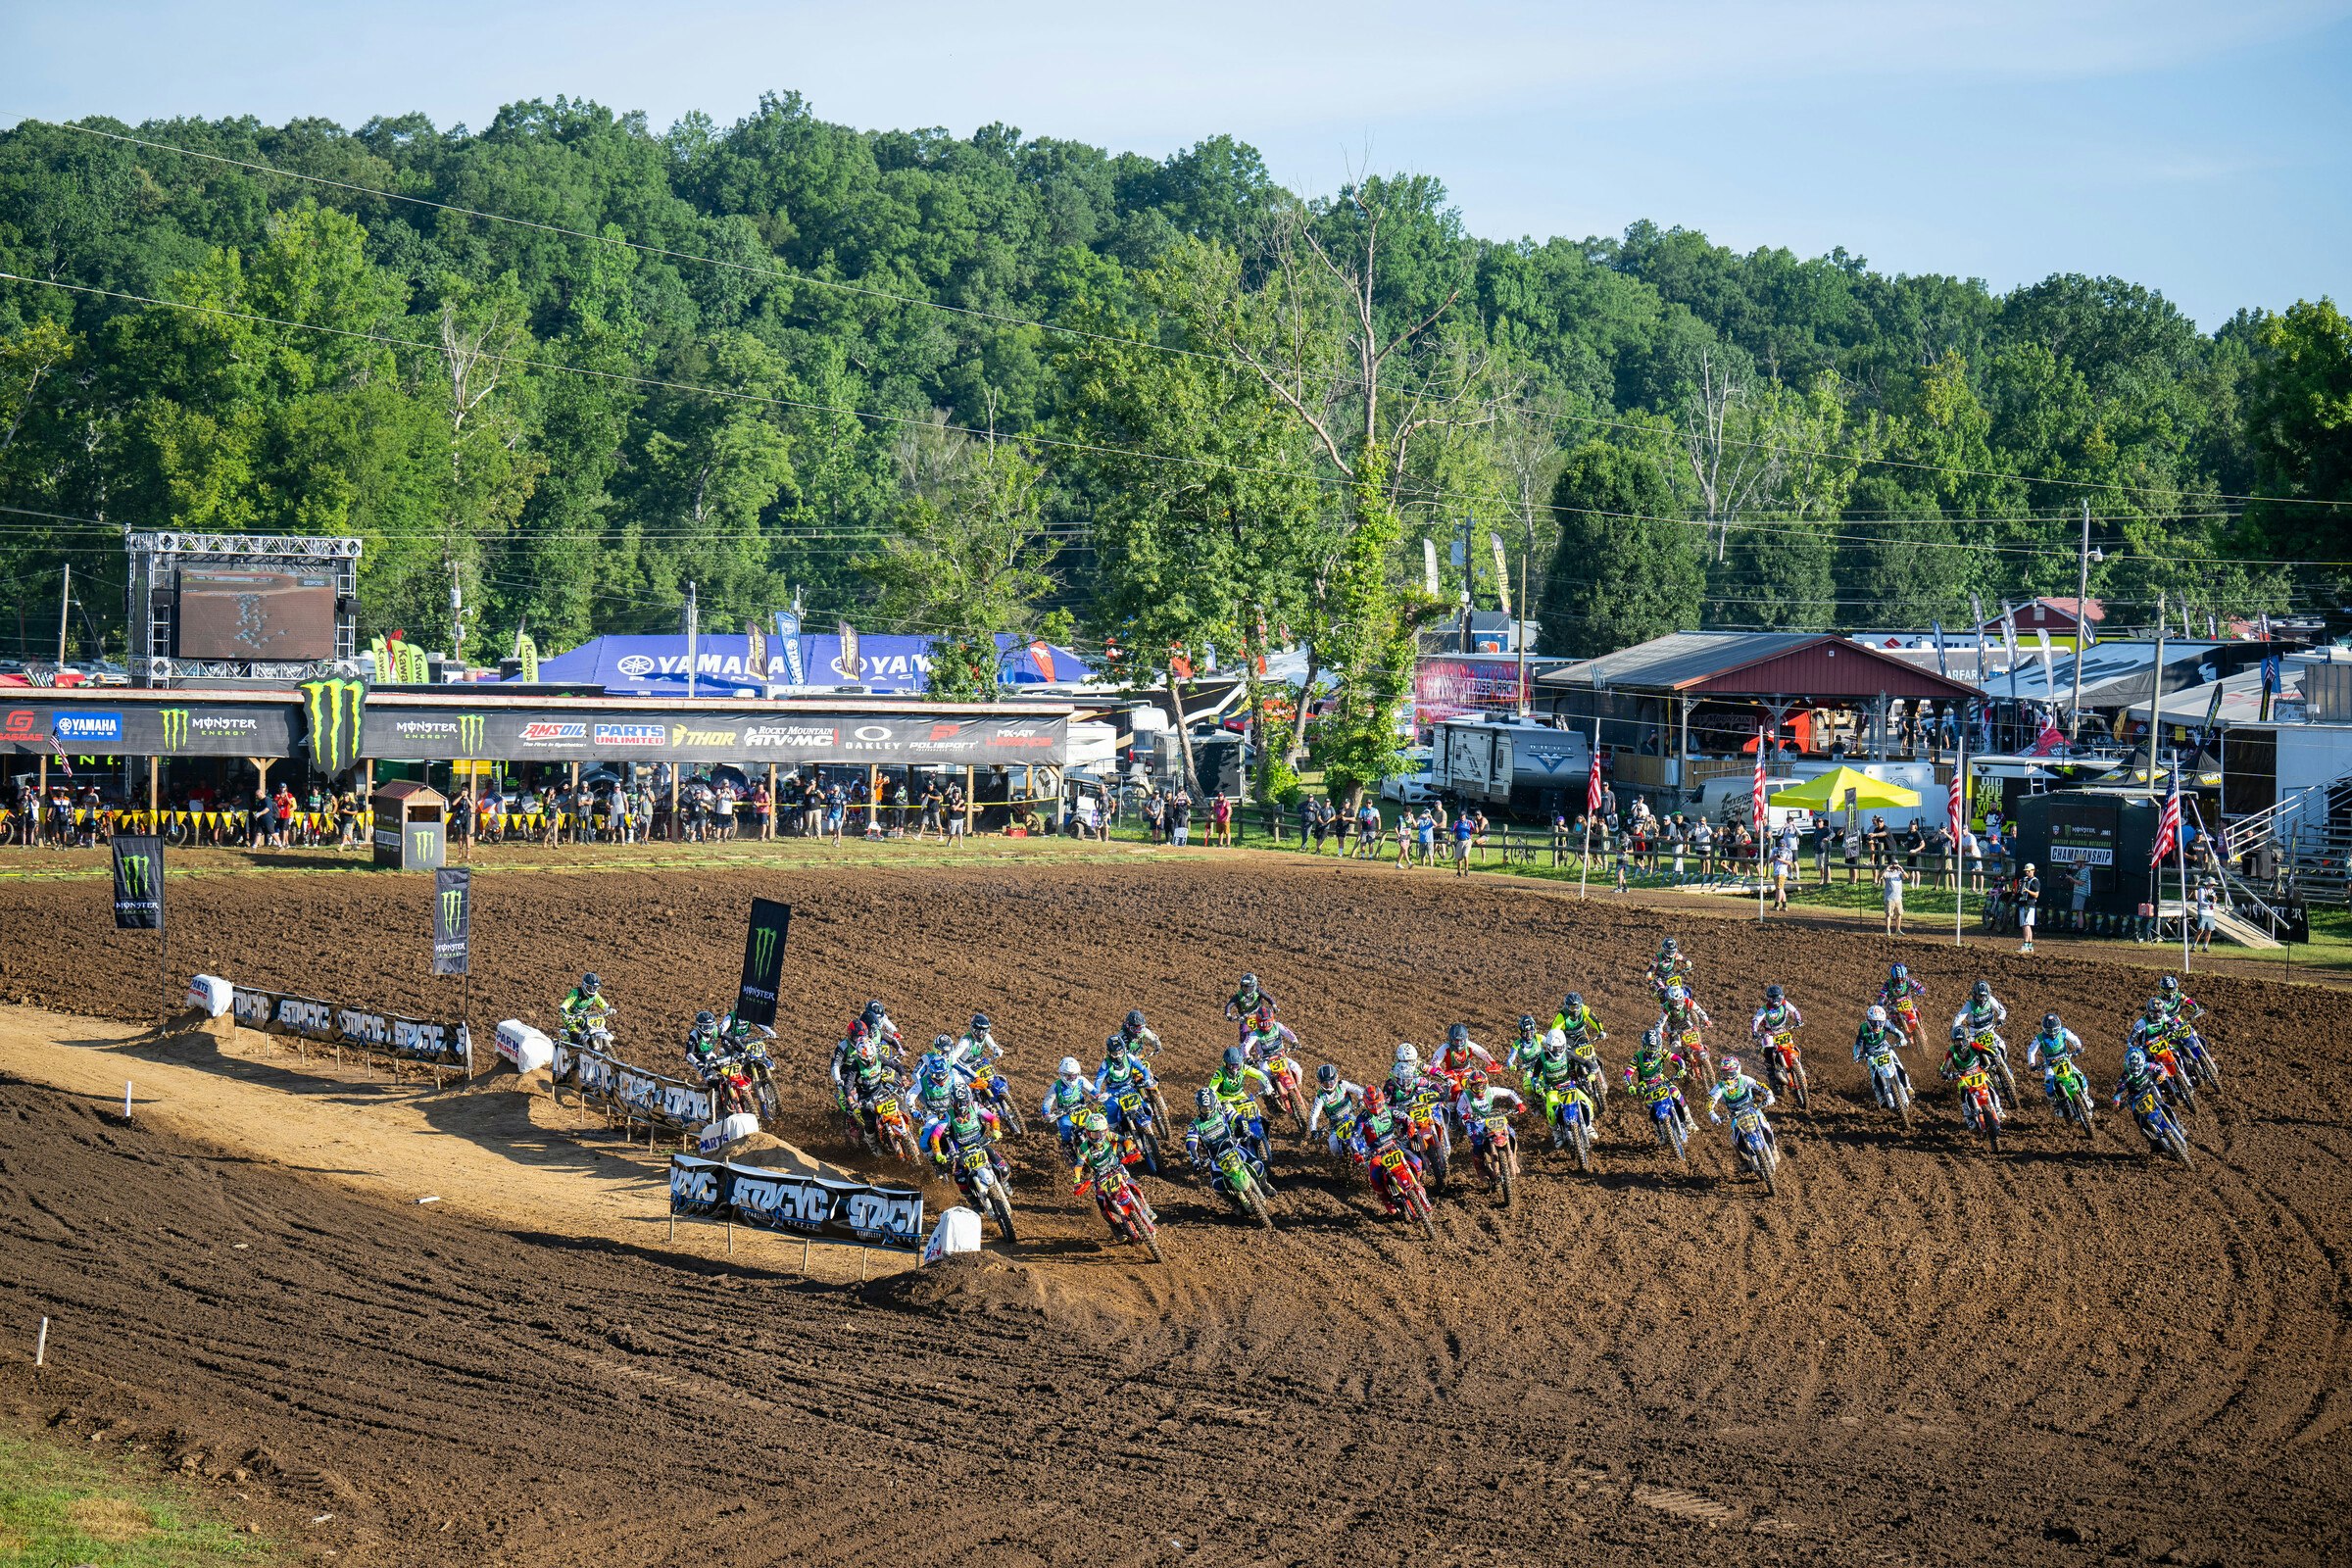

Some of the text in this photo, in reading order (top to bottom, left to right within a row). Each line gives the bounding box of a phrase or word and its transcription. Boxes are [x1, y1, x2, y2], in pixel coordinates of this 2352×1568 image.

[658, 654, 786, 676] YAMAA
[72, 718, 118, 731] YAMAHA
[192, 718, 257, 731] MONSTER
[396, 720, 459, 733] MONSTER
[527, 723, 586, 736] AMSOIL
[596, 725, 664, 737] PARTS
[759, 726, 833, 735] ROCKY MOUNTAIN
[687, 732, 736, 746] THOR
[1981, 777, 2004, 786] DID
[1977, 794, 2003, 803] SEE
[1977, 802, 2003, 811] YOR
[2052, 848, 2111, 863] CHAMPONSHIP
[115, 901, 160, 910] MONSTER
[435, 942, 466, 954] MONSTER
[743, 985, 776, 1002] MONSTER
[2152, 1042, 2168, 1054] 34
[1878, 1054, 1890, 1067] 65
[2057, 1063, 2071, 1075] 41
[1969, 1074, 1983, 1087] 11
[1560, 1090, 1575, 1104] 71
[1653, 1088, 1668, 1101] 52
[881, 1100, 897, 1114] 45
[1413, 1109, 1430, 1121] 24
[967, 1152, 987, 1169] 84
[1385, 1152, 1402, 1167] 90
[730, 1177, 830, 1221] STACYC
